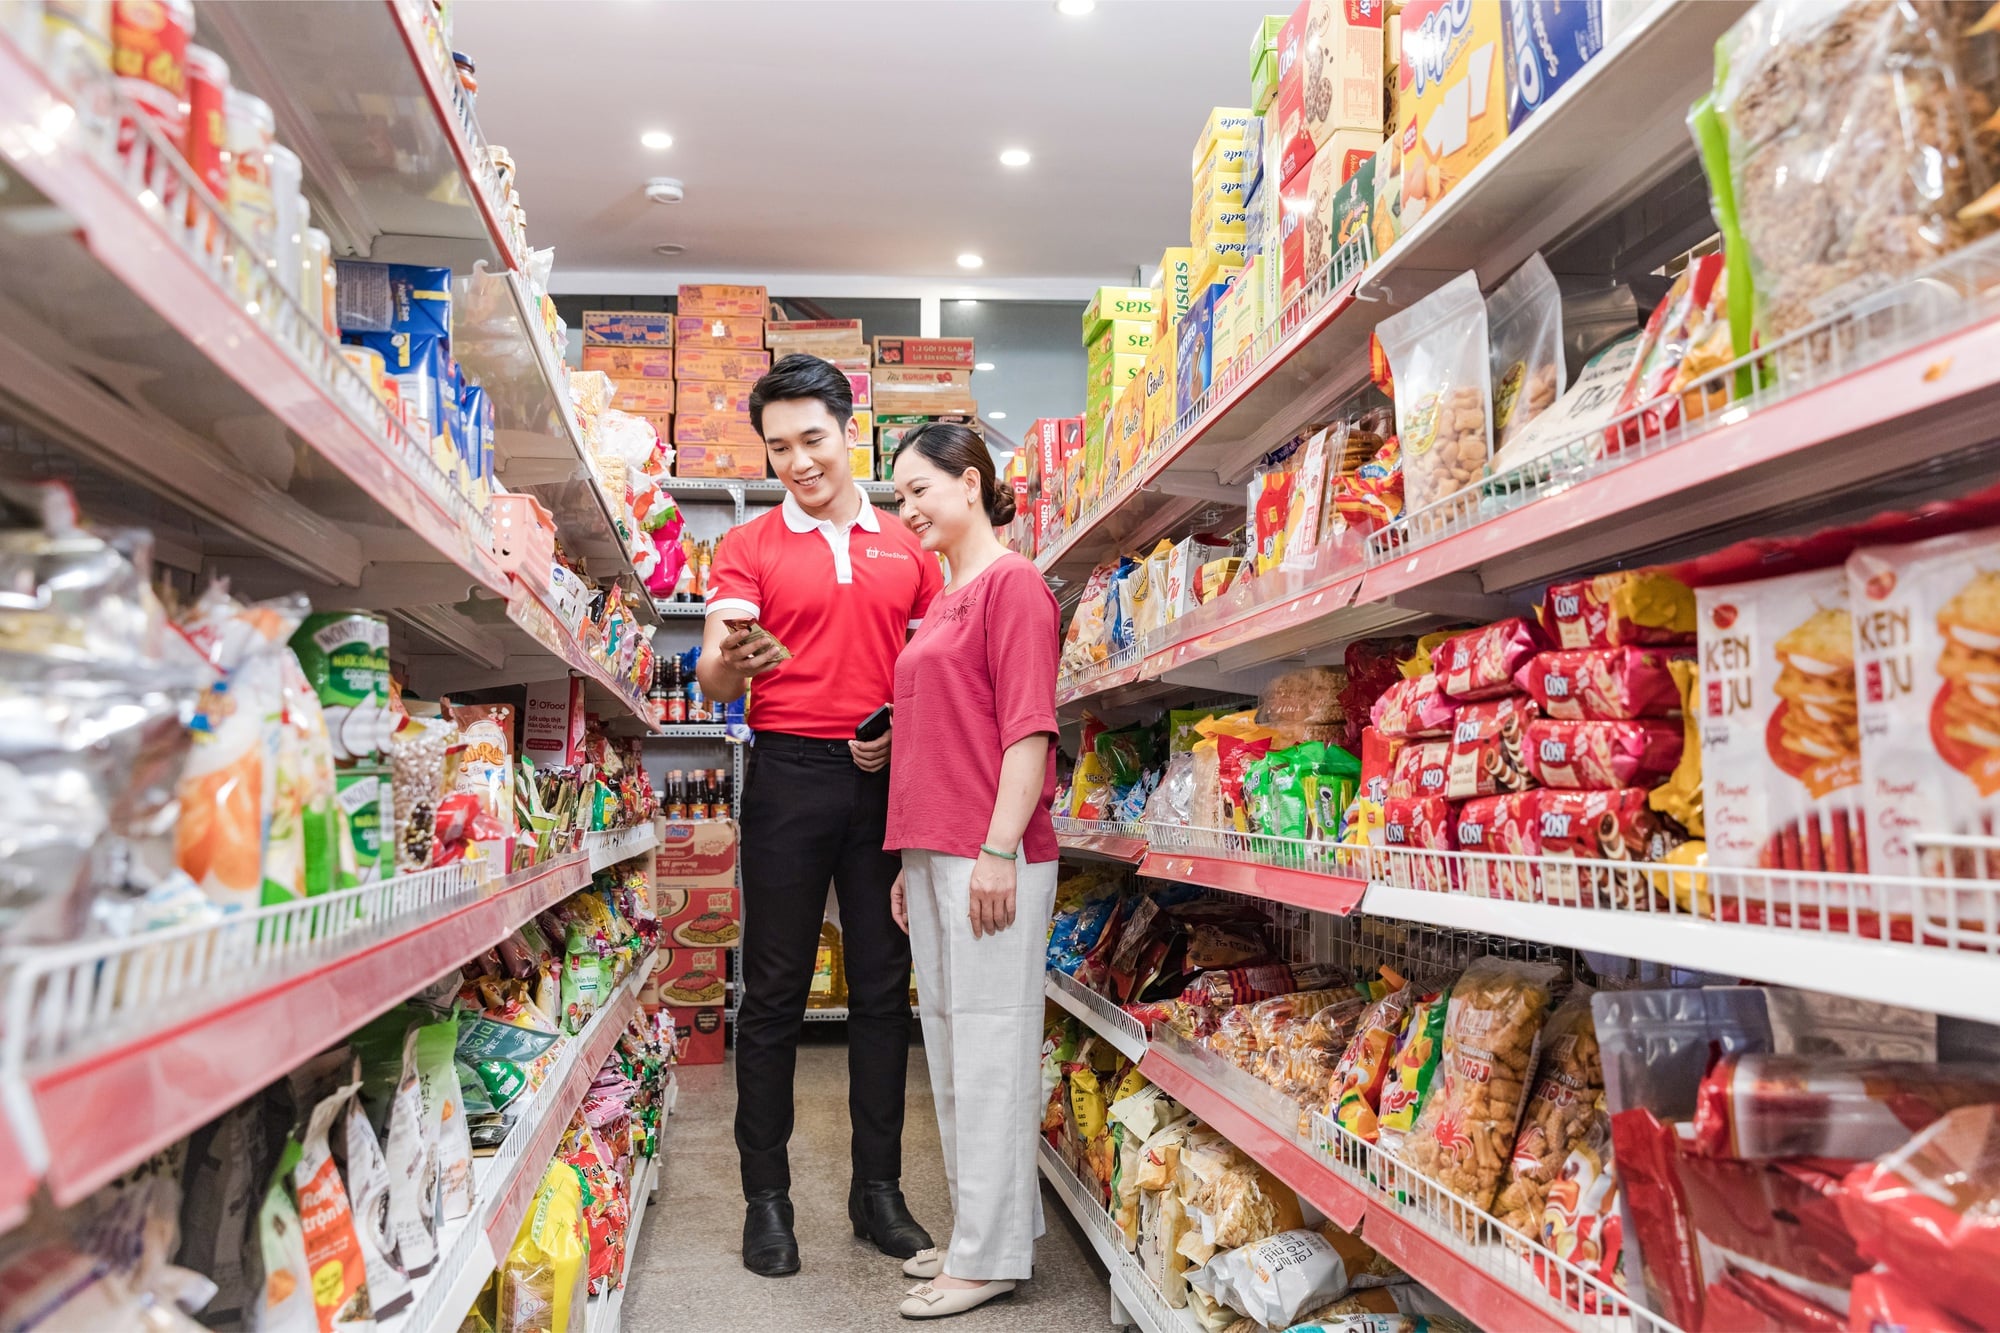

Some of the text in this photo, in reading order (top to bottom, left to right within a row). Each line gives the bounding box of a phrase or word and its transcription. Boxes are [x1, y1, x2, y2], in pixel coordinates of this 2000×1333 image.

[1279, 34, 1301, 83] COSY
[1280, 208, 1299, 244] COSY
[1177, 323, 1197, 369] OREO
[1043, 424, 1054, 475] CHOCOPIE
[880, 551, 909, 561] OneShop
[1554, 595, 1580, 617] COSY
[1858, 606, 1911, 651] KEN
[1452, 649, 1470, 671] COSY
[1704, 635, 1751, 673] KEN
[1544, 674, 1569, 697] COSY
[1886, 655, 1913, 698] JU
[1727, 676, 1753, 714] JU
[1456, 722, 1483, 744] COSY
[1540, 739, 1567, 763] COSY
[1086, 774, 1105, 783] Tipo
[1368, 774, 1388, 807] Ti
[1421, 768, 1444, 788] COSY
[1385, 822, 1405, 844] COSY
[1458, 822, 1484, 845] COSY
[1541, 812, 1572, 839] COSY
